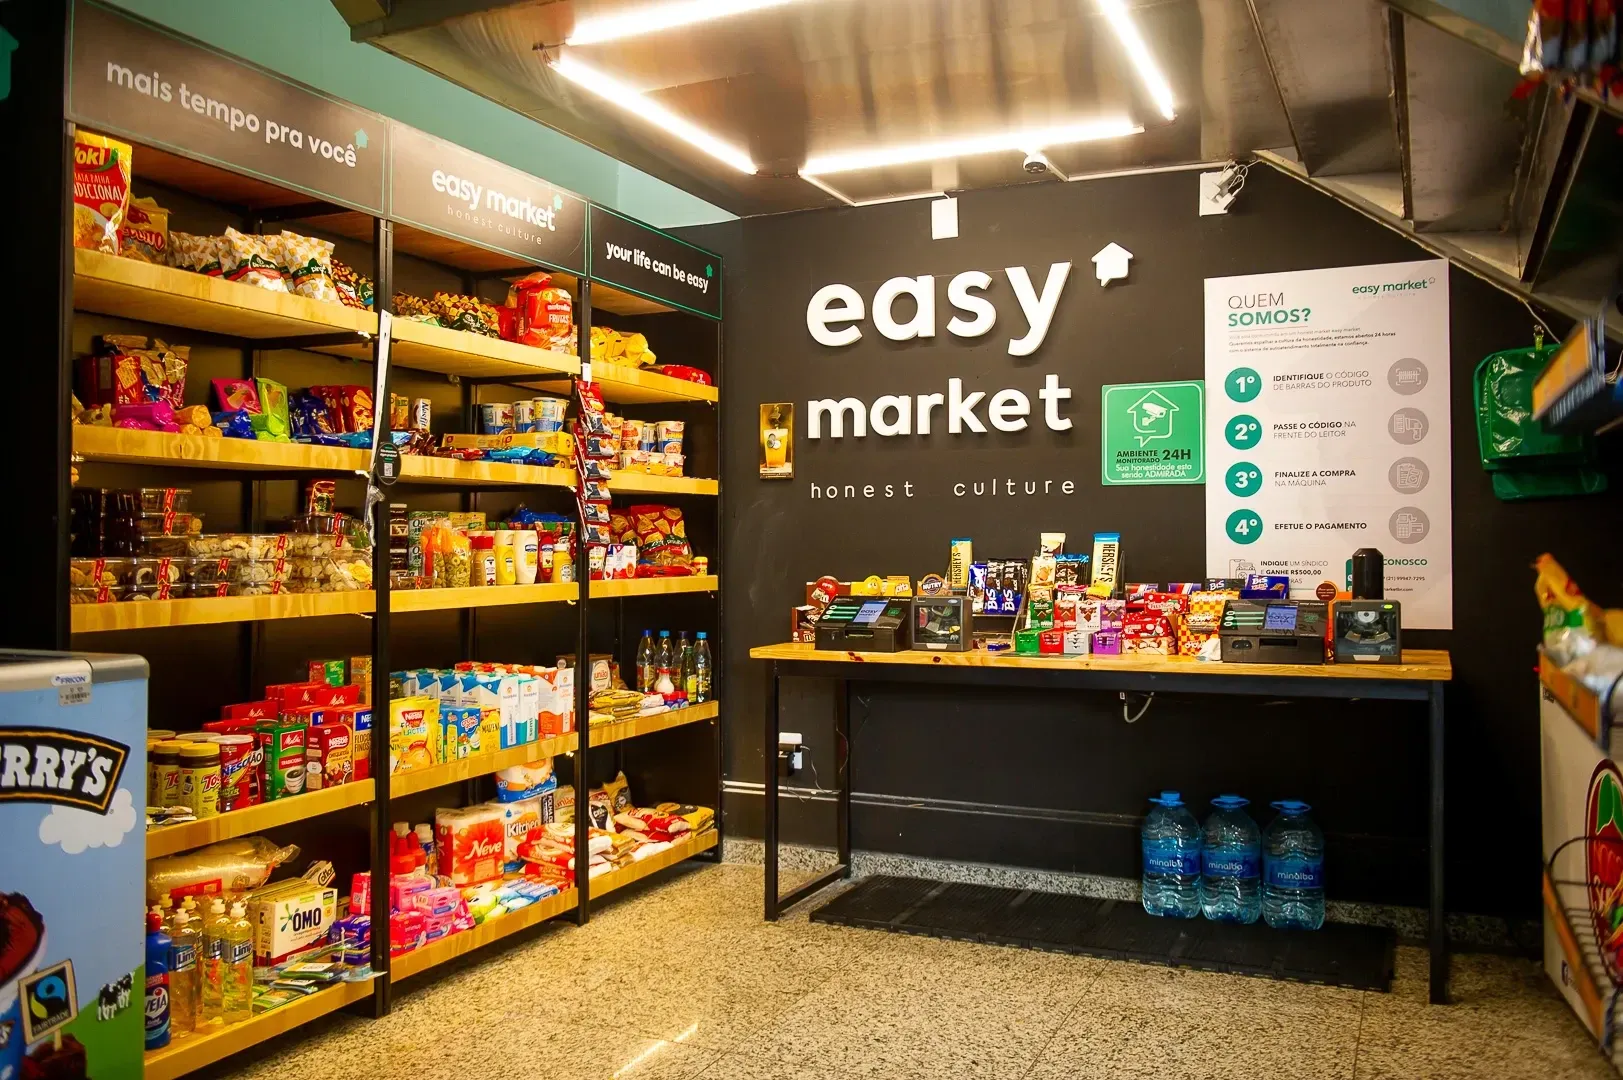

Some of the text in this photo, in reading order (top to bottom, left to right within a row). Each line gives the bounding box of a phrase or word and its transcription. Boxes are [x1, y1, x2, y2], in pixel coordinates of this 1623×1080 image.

[107, 61, 357, 168] mais tempo pra você
[431, 169, 556, 232] easy market
[447, 204, 542, 245] honest culture
[606, 241, 709, 294] your life can be easy
[1352, 279, 1428, 295] easy market
[806, 259, 1072, 356] easy
[1228, 292, 1284, 310] QUEM
[1228, 307, 1311, 327] SOMOS?
[1273, 372, 1324, 382] IDENTIFIQUE
[1334, 370, 1369, 379] CÓDIGO
[1273, 379, 1372, 391] DE BARRAS DO PRODUTO
[807, 374, 1073, 439] market
[1299, 422, 1307, 430] O
[1308, 420, 1343, 429] CÓDIGO
[1344, 420, 1356, 428] NA
[1273, 429, 1346, 439] FRENTE DO LEITOR
[1116, 449, 1191, 460] AMBIENTE 24H
[1116, 464, 1130, 472] Sua
[1131, 462, 1176, 471] honestidade
[1274, 470, 1310, 478] FINALIZE
[1319, 469, 1356, 477] COMPRA
[1121, 470, 1187, 479] sendo ADMIRADA
[810, 478, 1075, 499] honest culture
[1274, 478, 1327, 487] NA MÁQUINA
[1305, 522, 1313, 530] O
[1314, 522, 1367, 530] PAGAMENTO
[952, 552, 962, 585] HERSHEY'S
[1301, 559, 1329, 567] SÍNDICO
[1, 744, 114, 797] RRY'S
[464, 837, 503, 860] Neve
[1149, 858, 1184, 869] minalba
[1208, 861, 1243, 872] minalba
[1277, 871, 1314, 882] minalba
[292, 907, 322, 932] OMO
